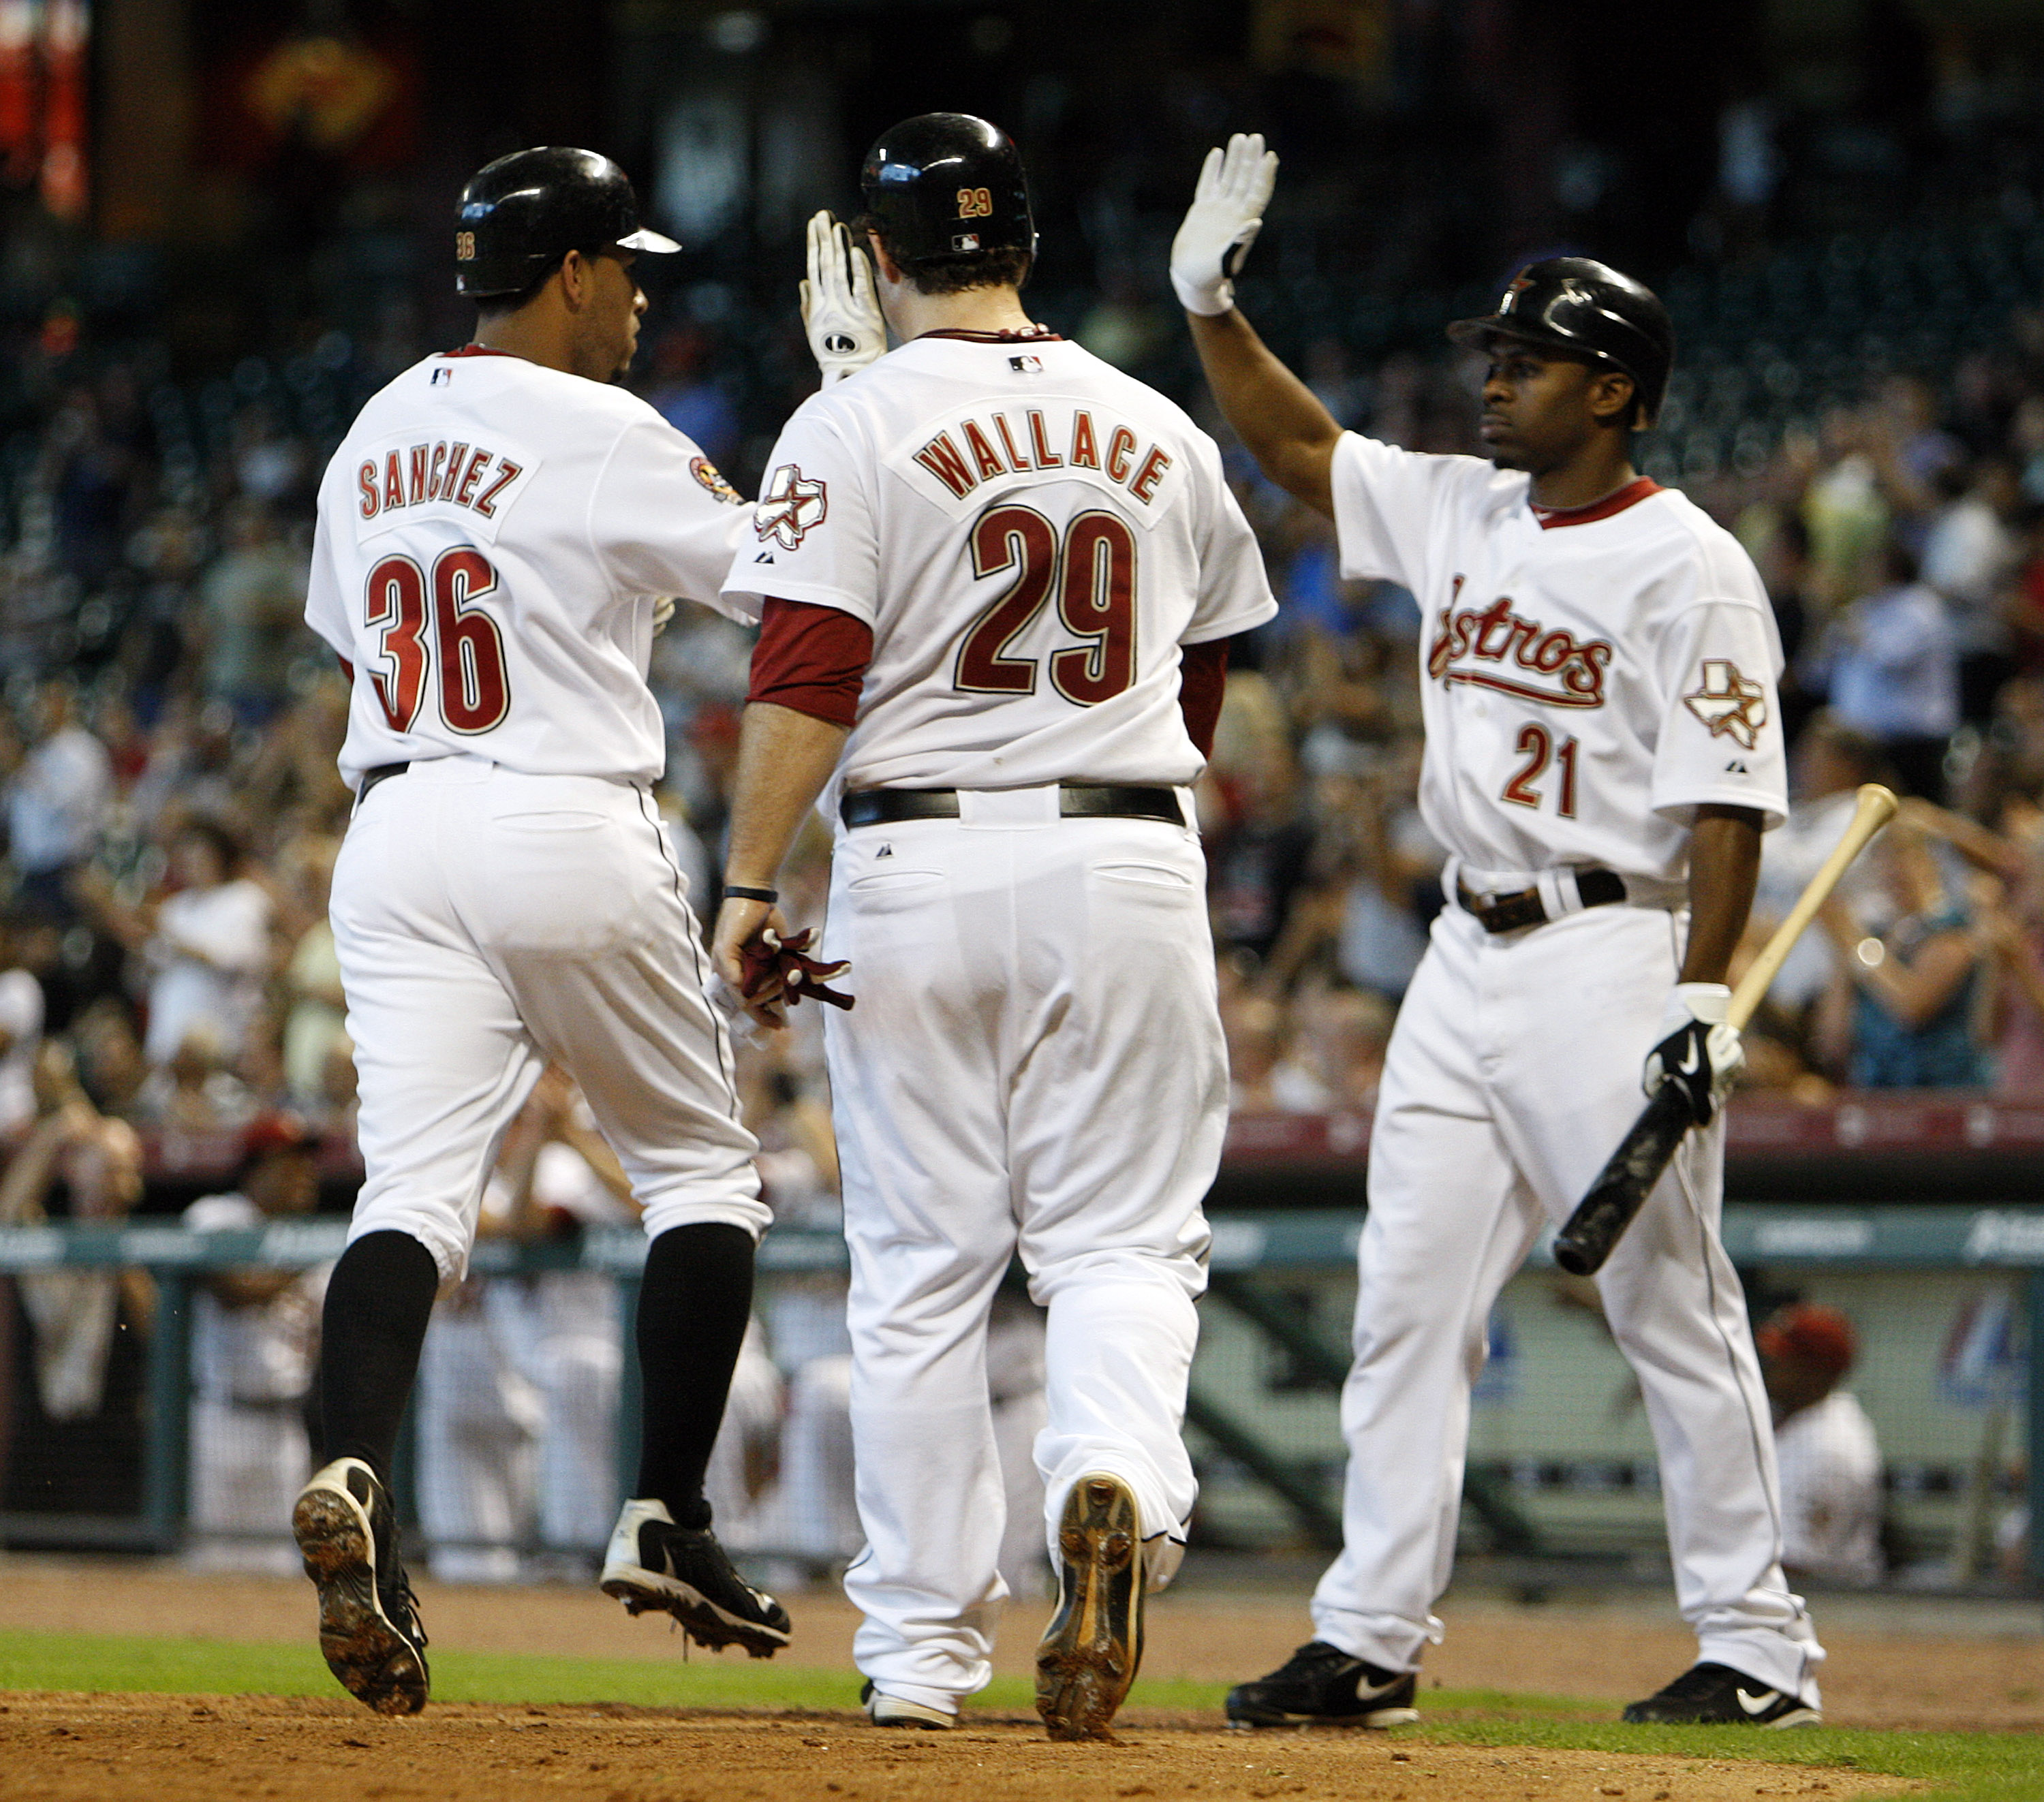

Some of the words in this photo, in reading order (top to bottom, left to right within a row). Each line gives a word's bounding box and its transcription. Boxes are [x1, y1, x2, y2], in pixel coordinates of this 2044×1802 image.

[957, 187, 993, 218] 29
[358, 441, 523, 520] SANCHEZ
[912, 409, 1173, 506] WALLACE
[365, 544, 511, 736] 36
[953, 504, 1138, 707] 29
[1500, 721, 1580, 819] 21
